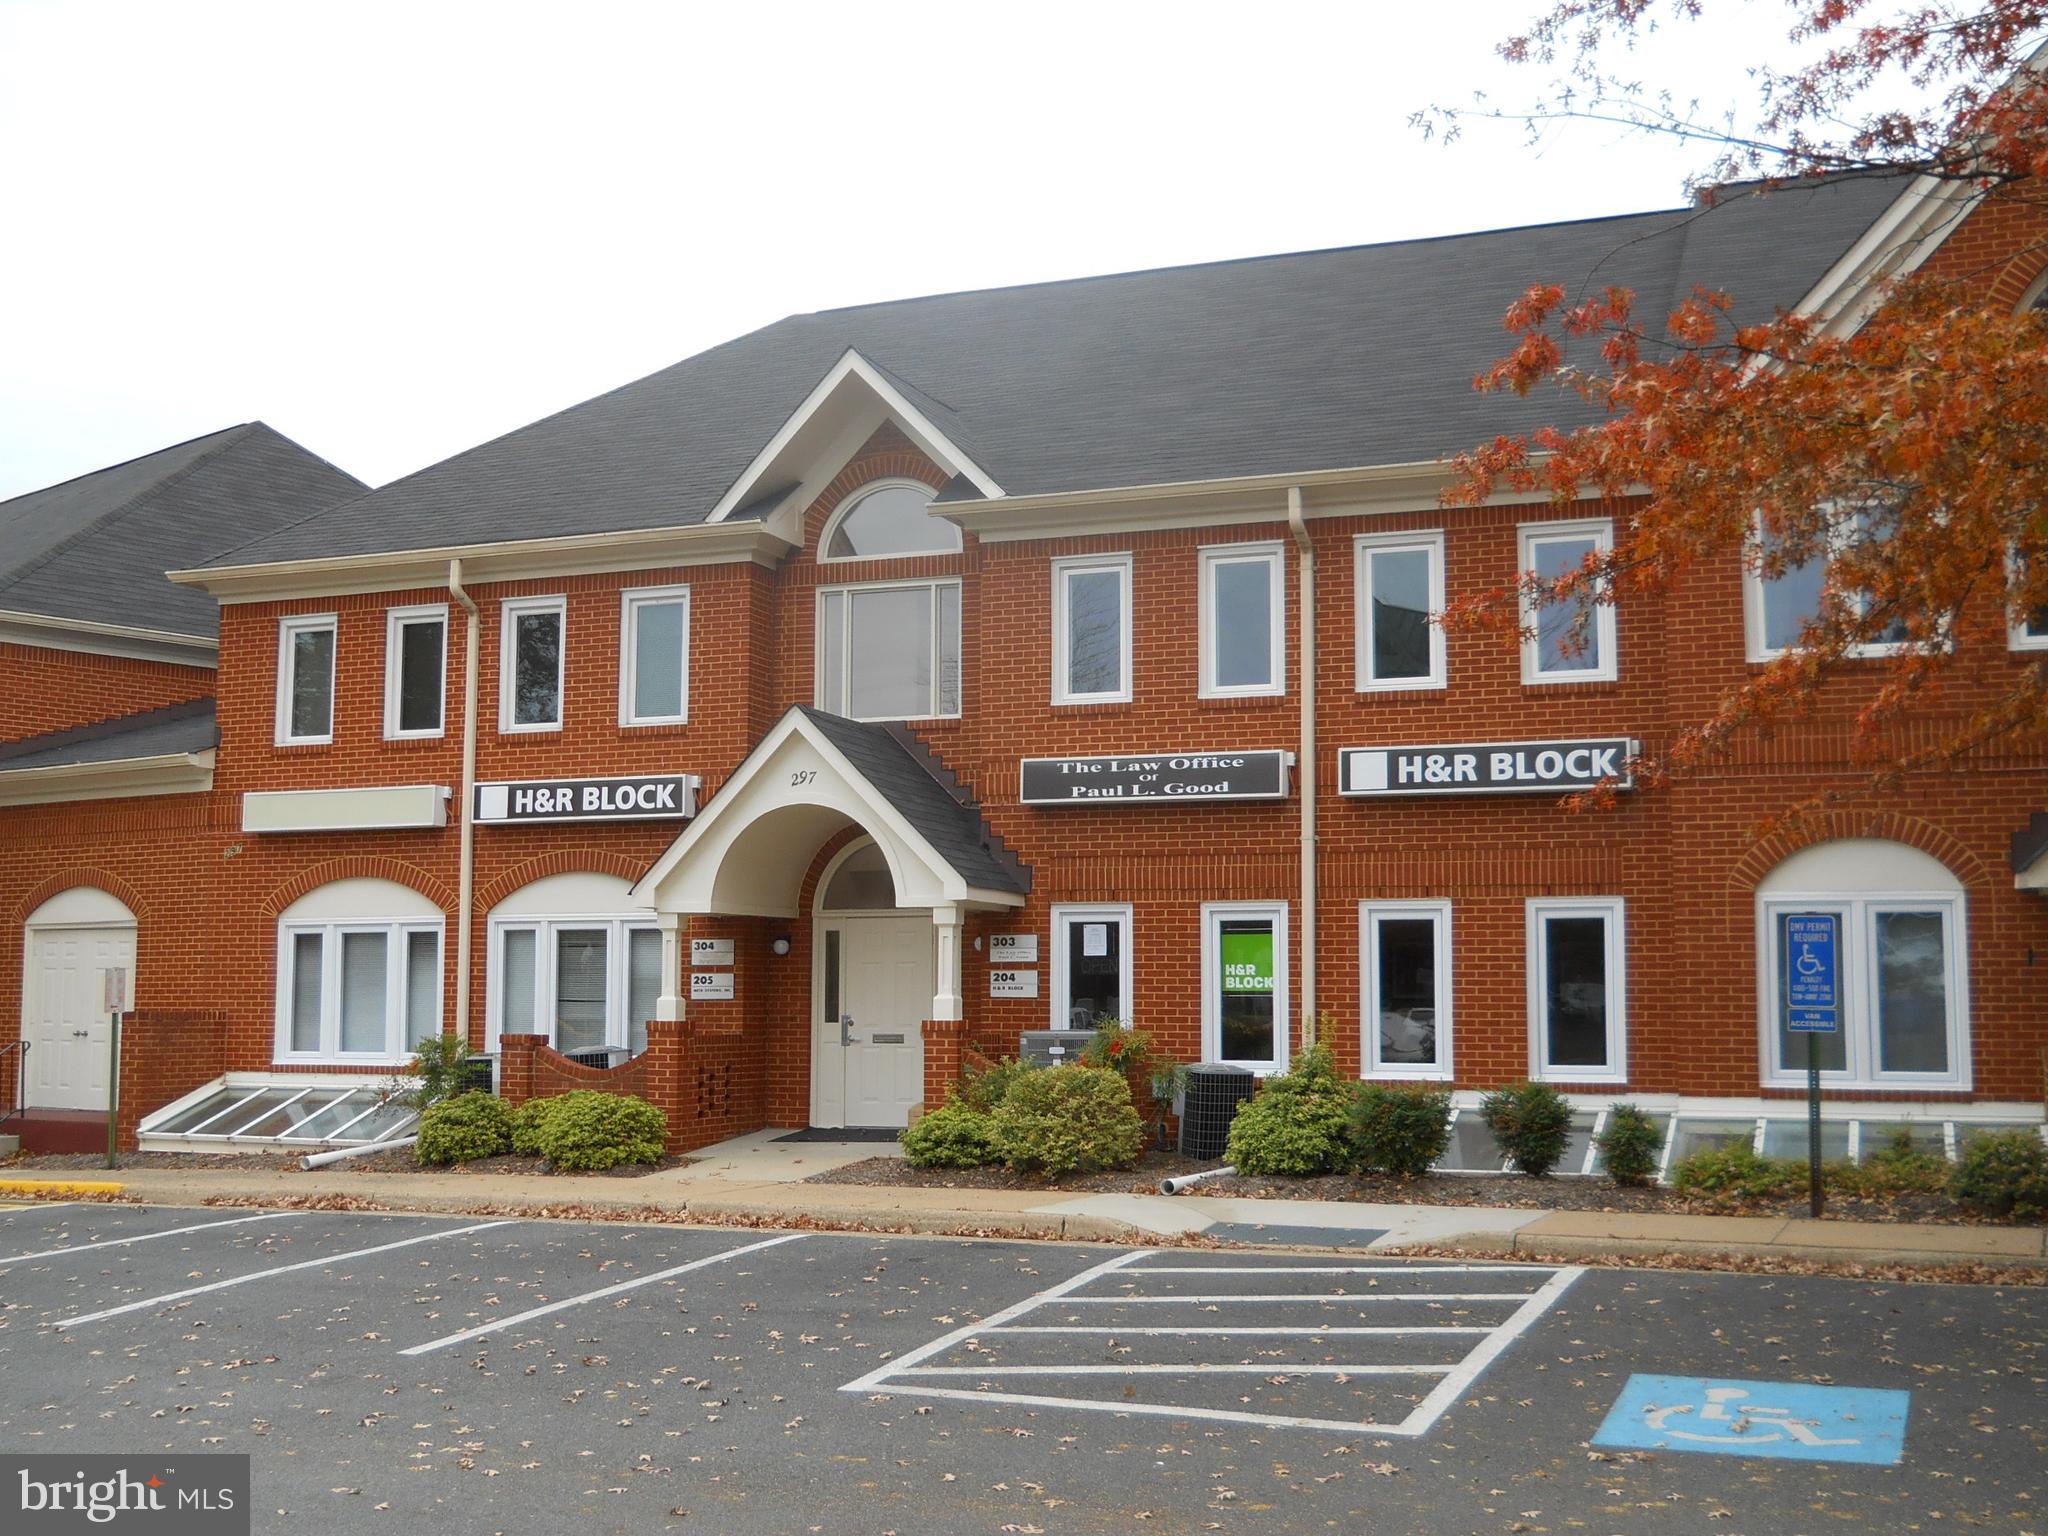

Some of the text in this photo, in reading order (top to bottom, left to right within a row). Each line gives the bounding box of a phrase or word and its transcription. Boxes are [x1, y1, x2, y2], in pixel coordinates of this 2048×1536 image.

[1057, 757, 1245, 774] The Law Office
[1398, 748, 1618, 783] H&R BLOCK
[791, 770, 817, 787] 297
[1139, 773, 1160, 782] Of
[1071, 781, 1229, 798] Paul L. Good
[515, 783, 676, 813] H&R BLOCK
[1790, 922, 1831, 931] DMV PERMIT
[992, 937, 1016, 947] 303
[1793, 933, 1828, 942] REQUIRED
[694, 942, 714, 951] 304
[1080, 959, 1119, 974] OPEN
[1225, 964, 1256, 976] H&R
[693, 975, 714, 985] 205
[993, 973, 1016, 982] 204
[1225, 976, 1274, 989] BLOCK
